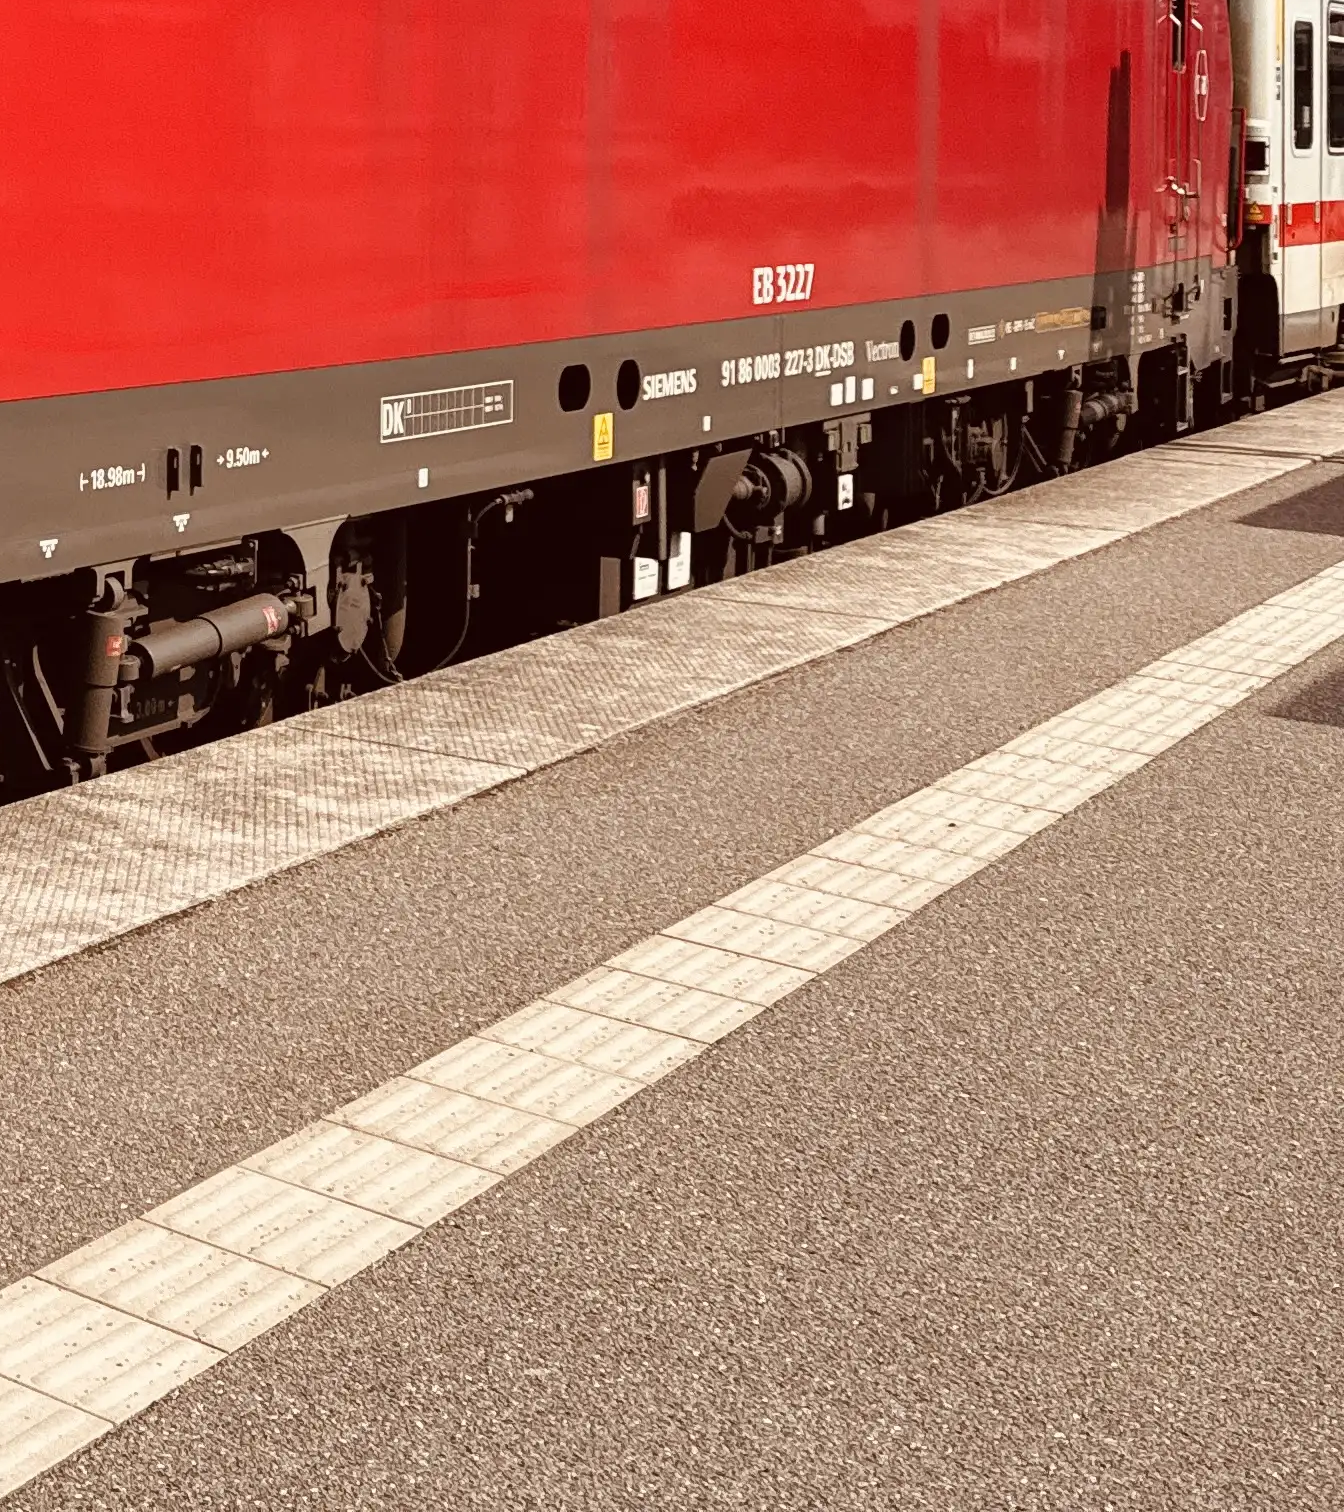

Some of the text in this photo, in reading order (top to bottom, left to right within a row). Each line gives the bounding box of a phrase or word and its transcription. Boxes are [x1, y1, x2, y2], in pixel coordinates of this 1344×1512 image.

[752, 263, 815, 305] EB 3227
[720, 341, 855, 387] 91 86 0003 227-3 DK-DSB
[642, 368, 697, 401] SIEMENS
[382, 400, 405, 437] DK
[226, 446, 261, 469] 9.50m
[90, 465, 136, 490] 18.98m
